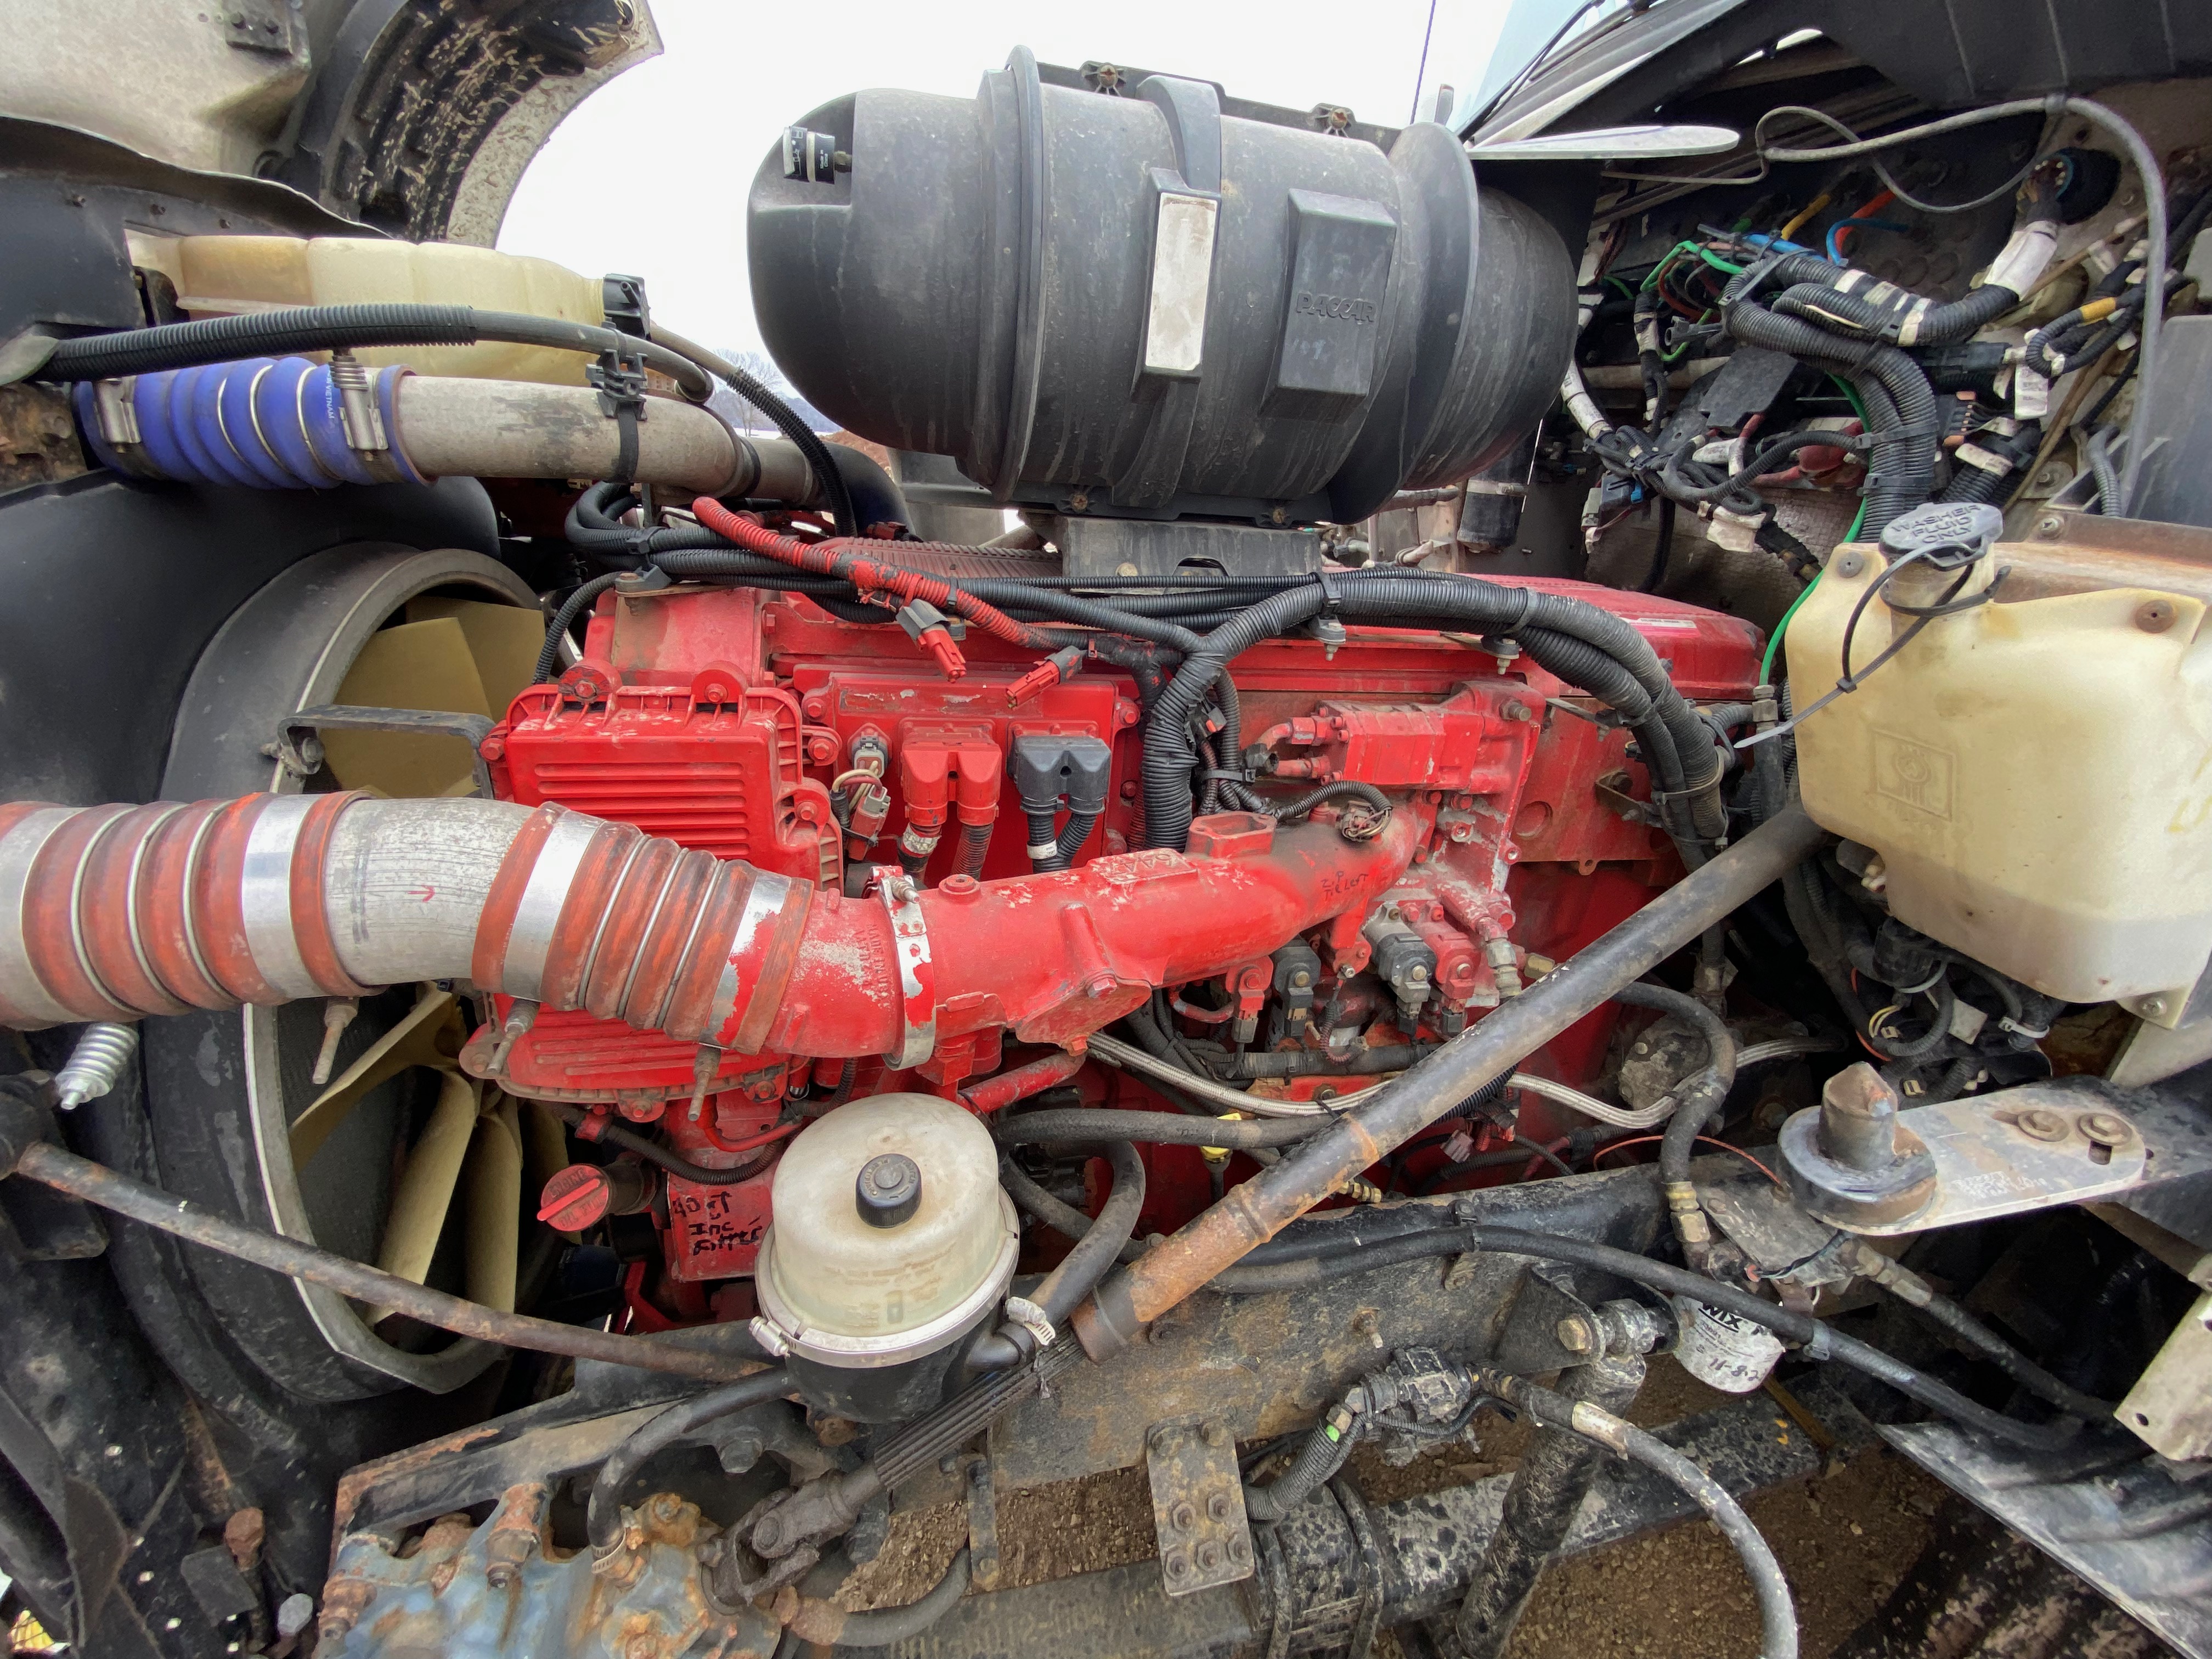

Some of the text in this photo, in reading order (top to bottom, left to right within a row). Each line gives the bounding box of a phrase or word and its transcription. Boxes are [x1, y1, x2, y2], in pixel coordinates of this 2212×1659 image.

[1296, 292, 1376, 322] PACCAR
[325, 385, 335, 419] VIETNAM
[1891, 505, 1981, 532] WASHER
[1911, 517, 1972, 537] FLUID
[1922, 524, 1972, 543] ONLY
[1702, 1301, 1740, 1330] WIX
